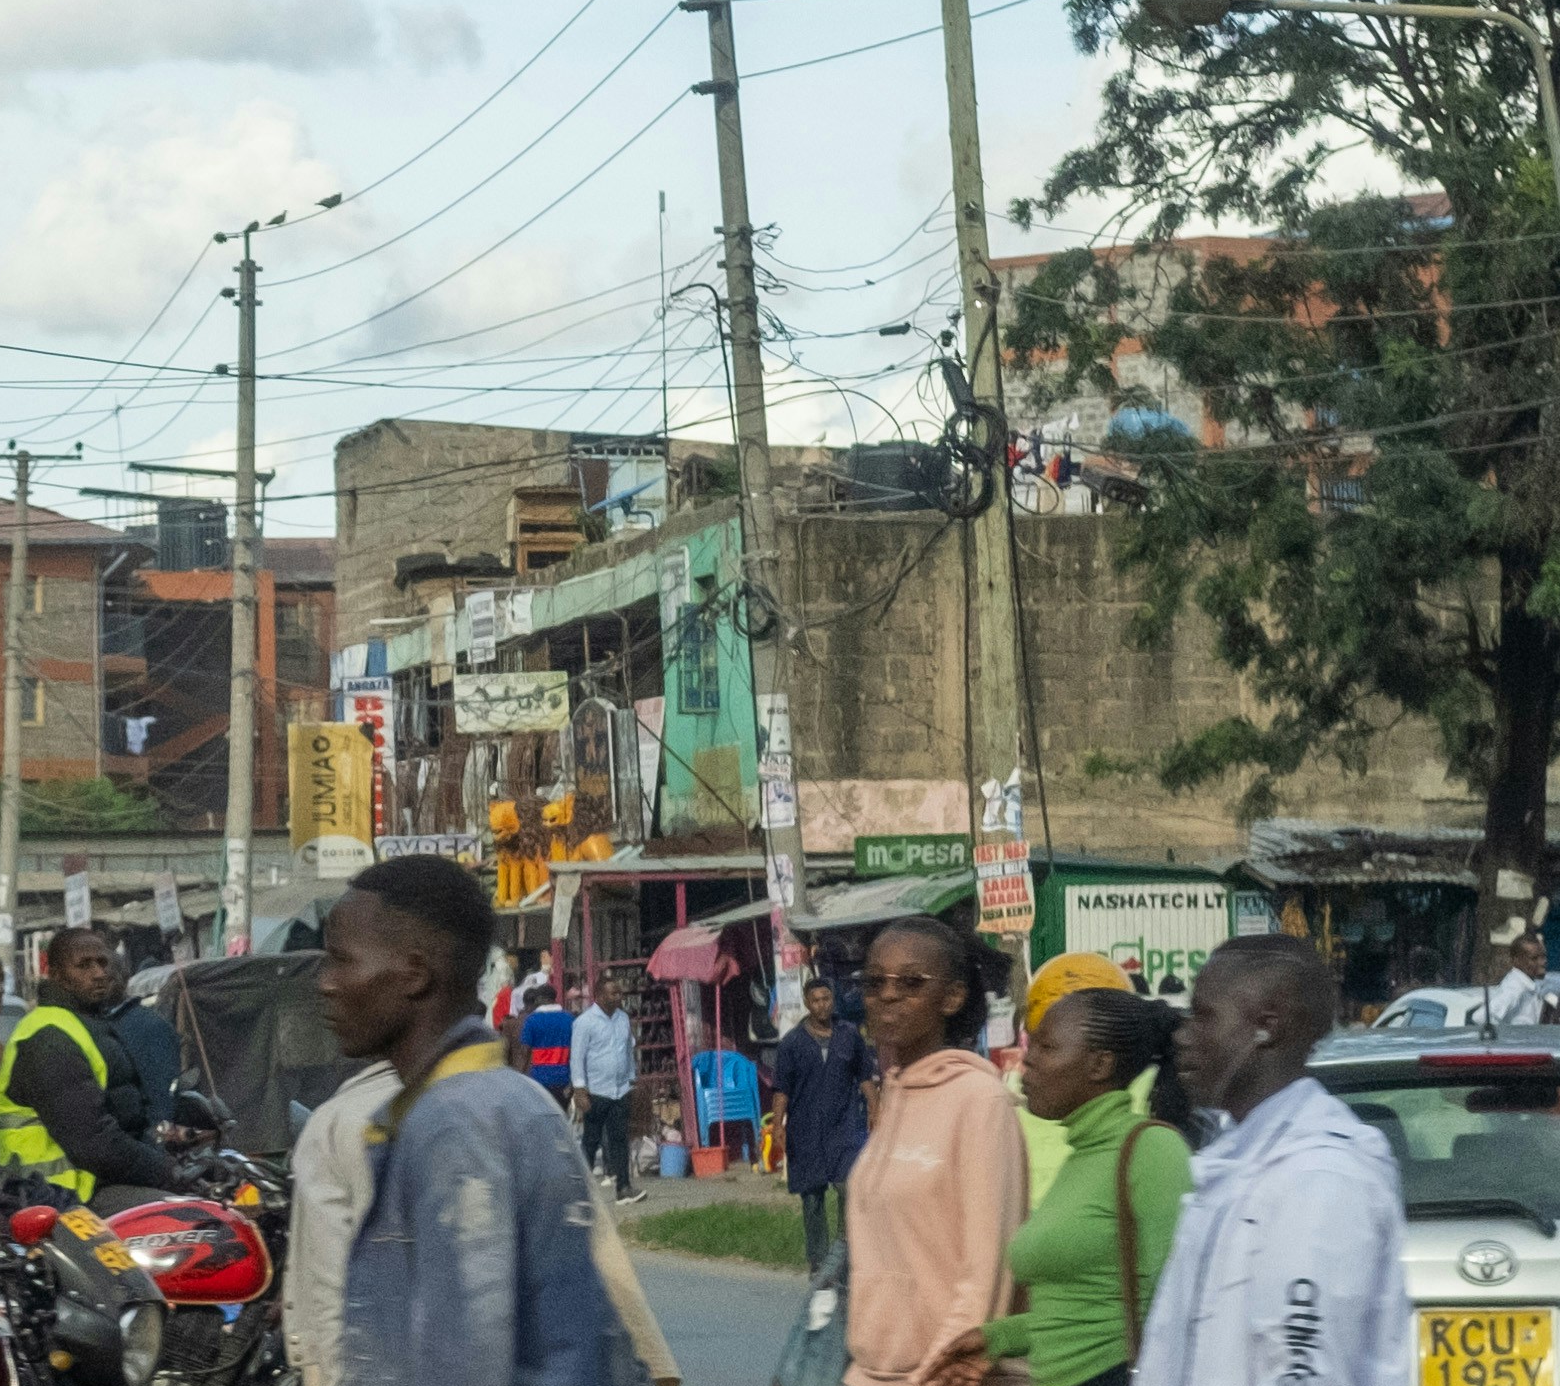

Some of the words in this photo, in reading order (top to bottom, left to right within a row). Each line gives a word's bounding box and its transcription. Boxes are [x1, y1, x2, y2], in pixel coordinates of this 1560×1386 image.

[310, 756, 337, 827] JUMIA
[984, 875, 1026, 893] SAUDI
[1078, 892, 1198, 909] NASHATECH
[127, 1229, 218, 1249] BOXER
